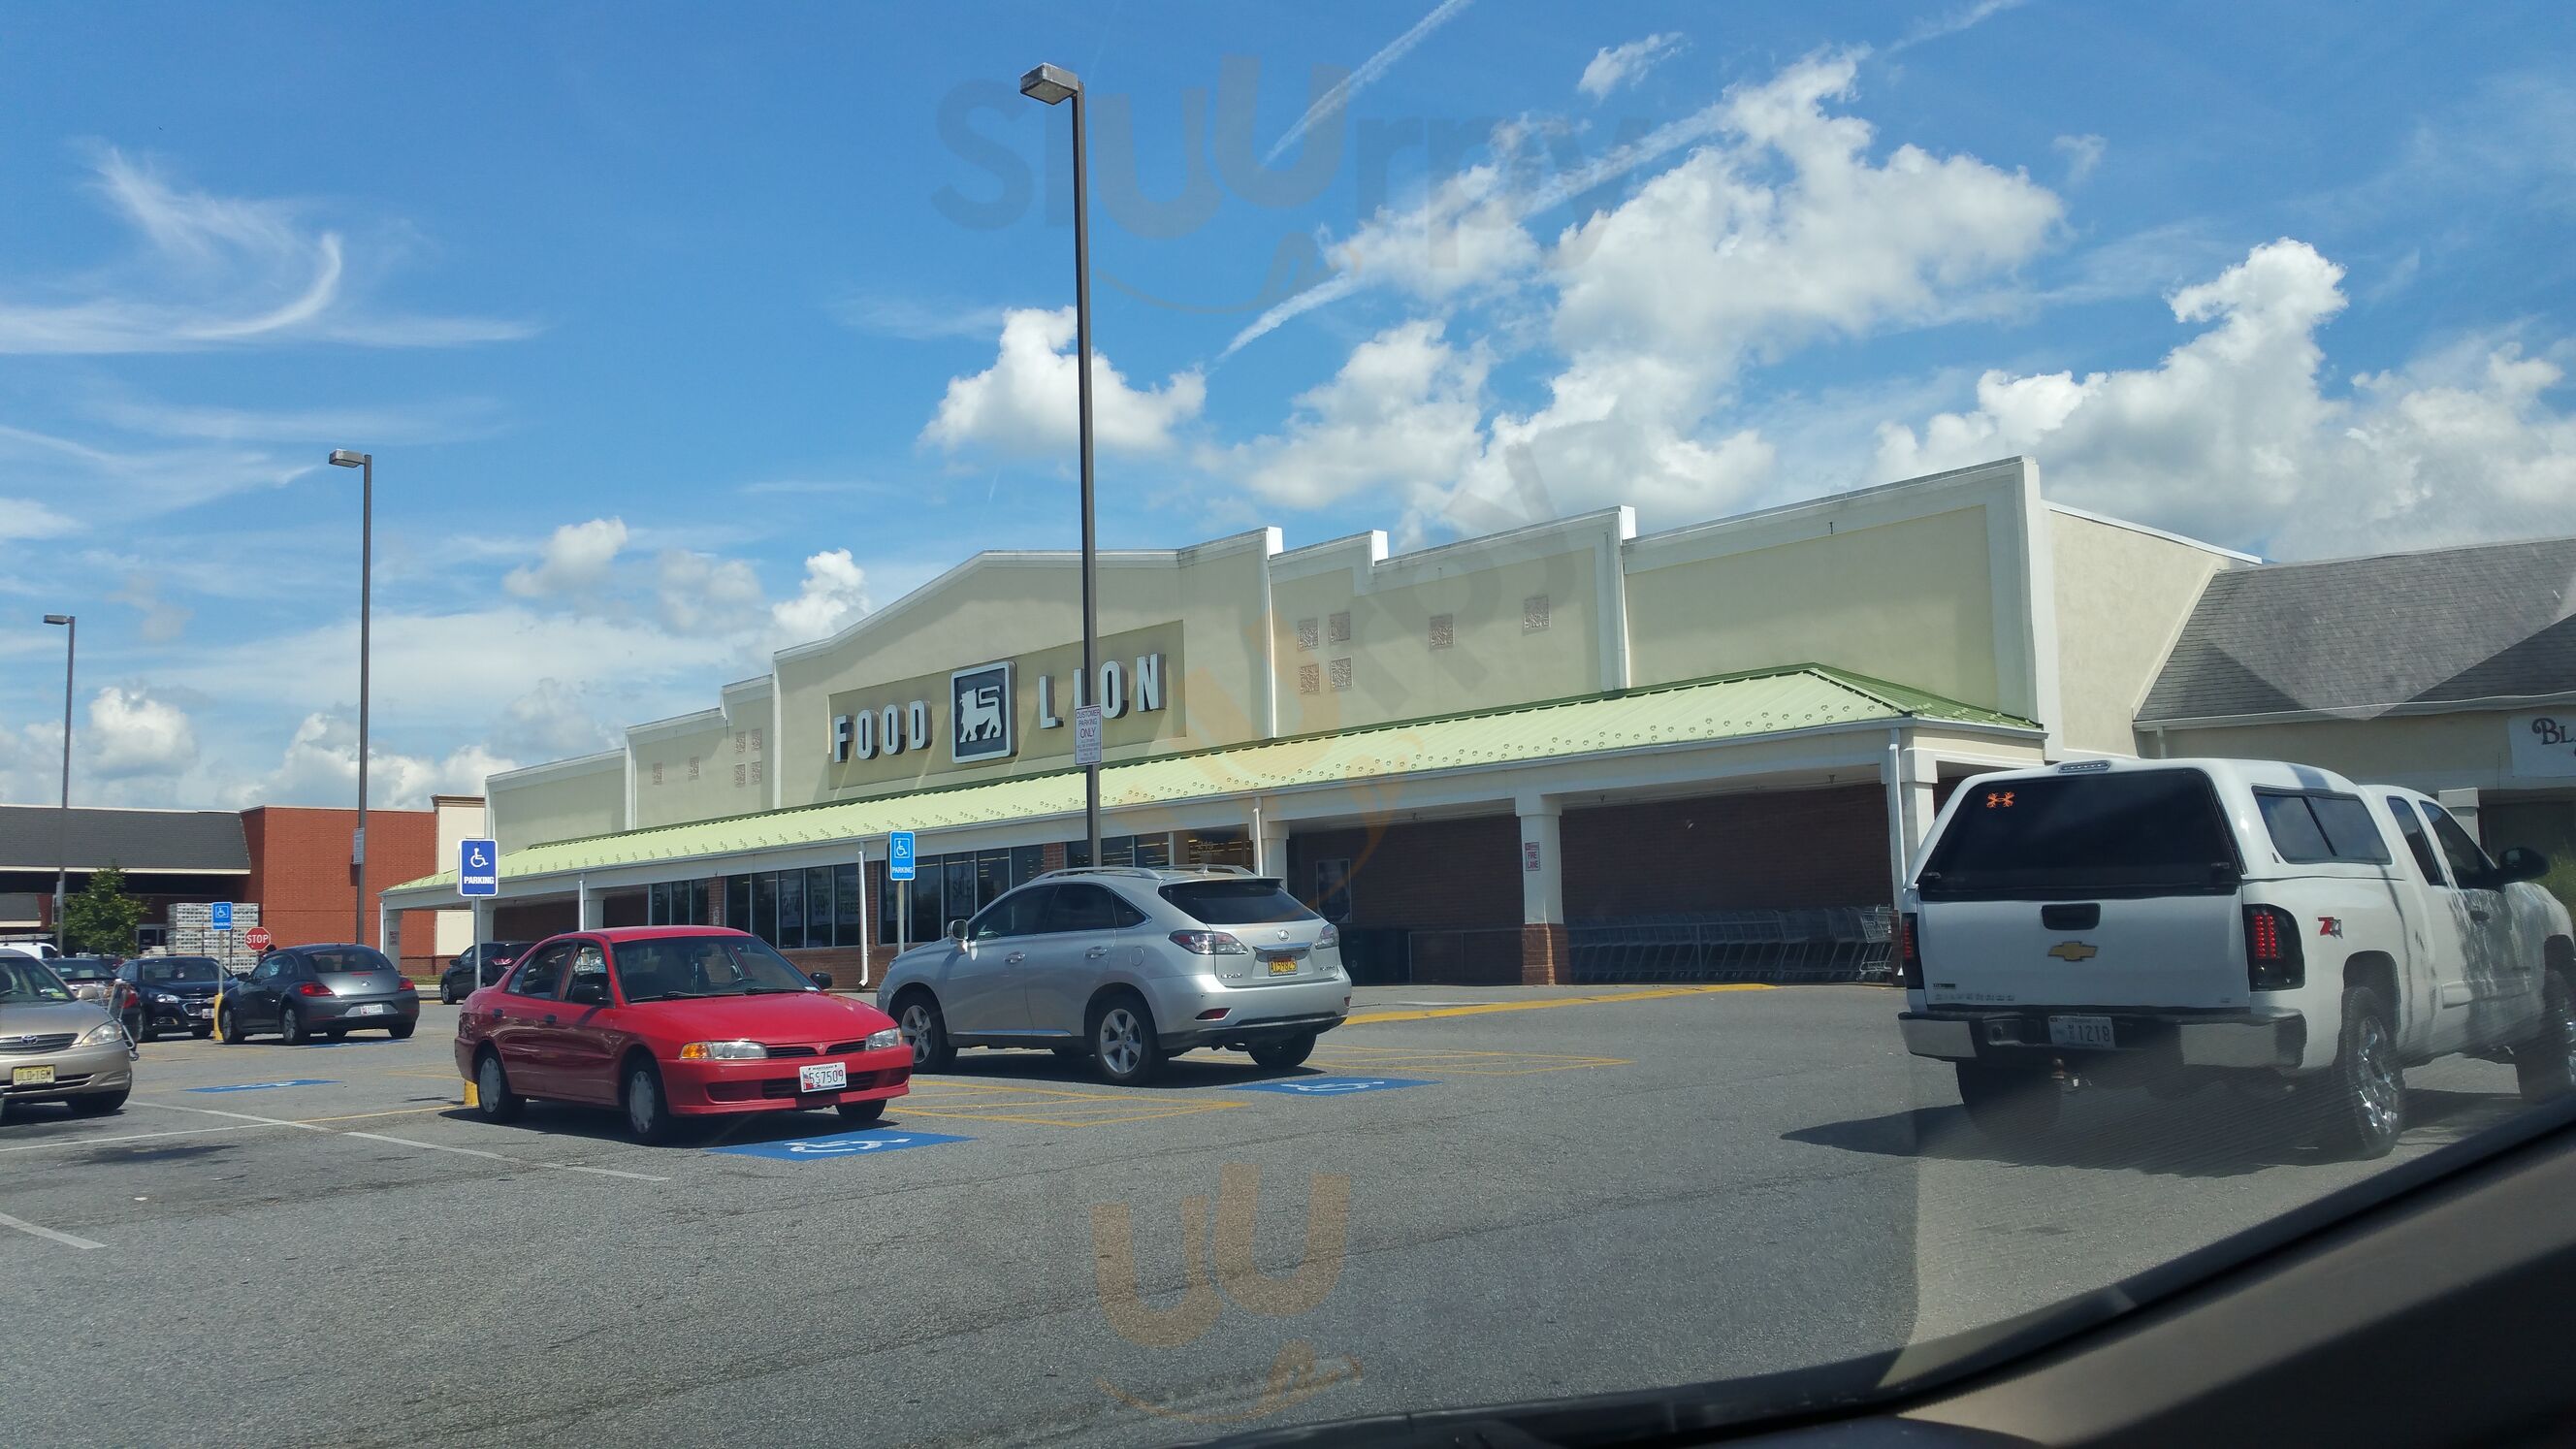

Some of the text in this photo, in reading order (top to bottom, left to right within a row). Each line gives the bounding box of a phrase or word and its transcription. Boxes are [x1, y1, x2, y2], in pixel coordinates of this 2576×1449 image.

[833, 653, 1167, 763] FOOD LION
[1077, 709, 1100, 720] CUSTOMER
[1079, 718, 1098, 726] PARKING
[1079, 727, 1096, 738] ONLY
[2531, 717, 2576, 745] BL
[464, 876, 495, 885] PARKING
[246, 934, 269, 944] STOP
